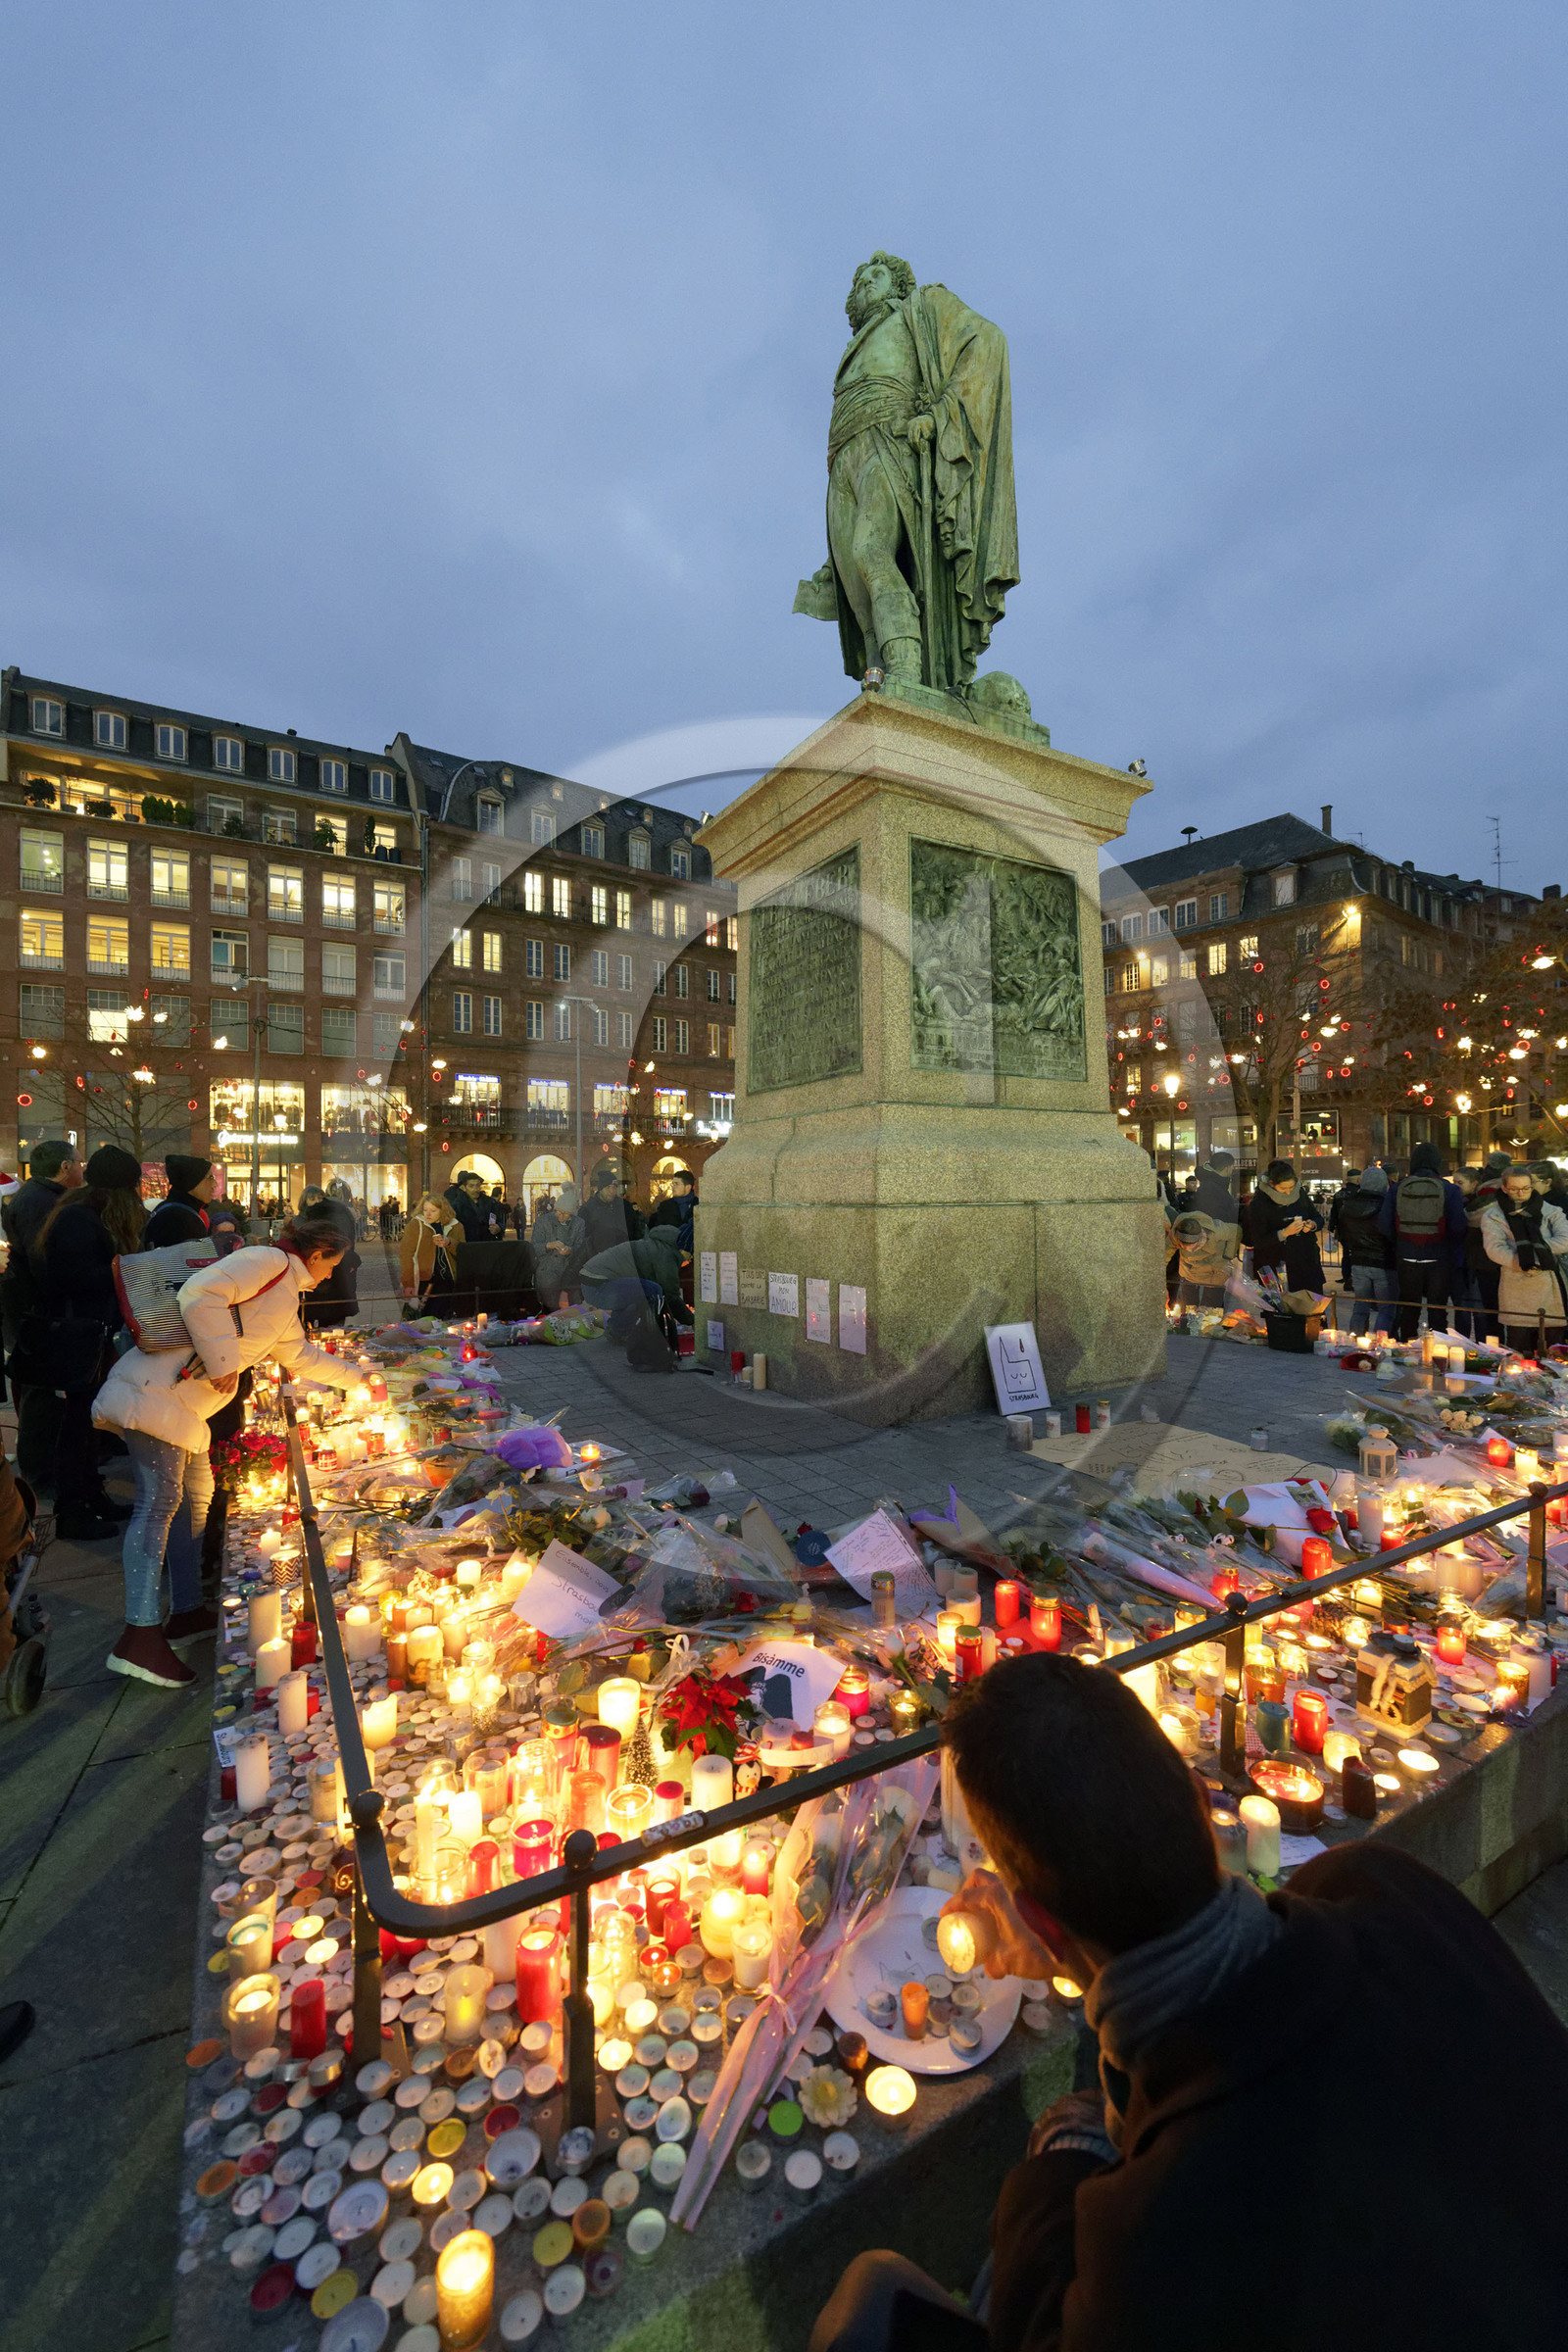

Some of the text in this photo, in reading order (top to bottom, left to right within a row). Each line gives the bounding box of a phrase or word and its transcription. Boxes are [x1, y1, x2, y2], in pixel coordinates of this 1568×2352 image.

[769, 1273, 797, 1286] STRASBOURG
[770, 1296, 798, 1314] AMOUR
[1008, 1393, 1039, 1402] STRASBOURG
